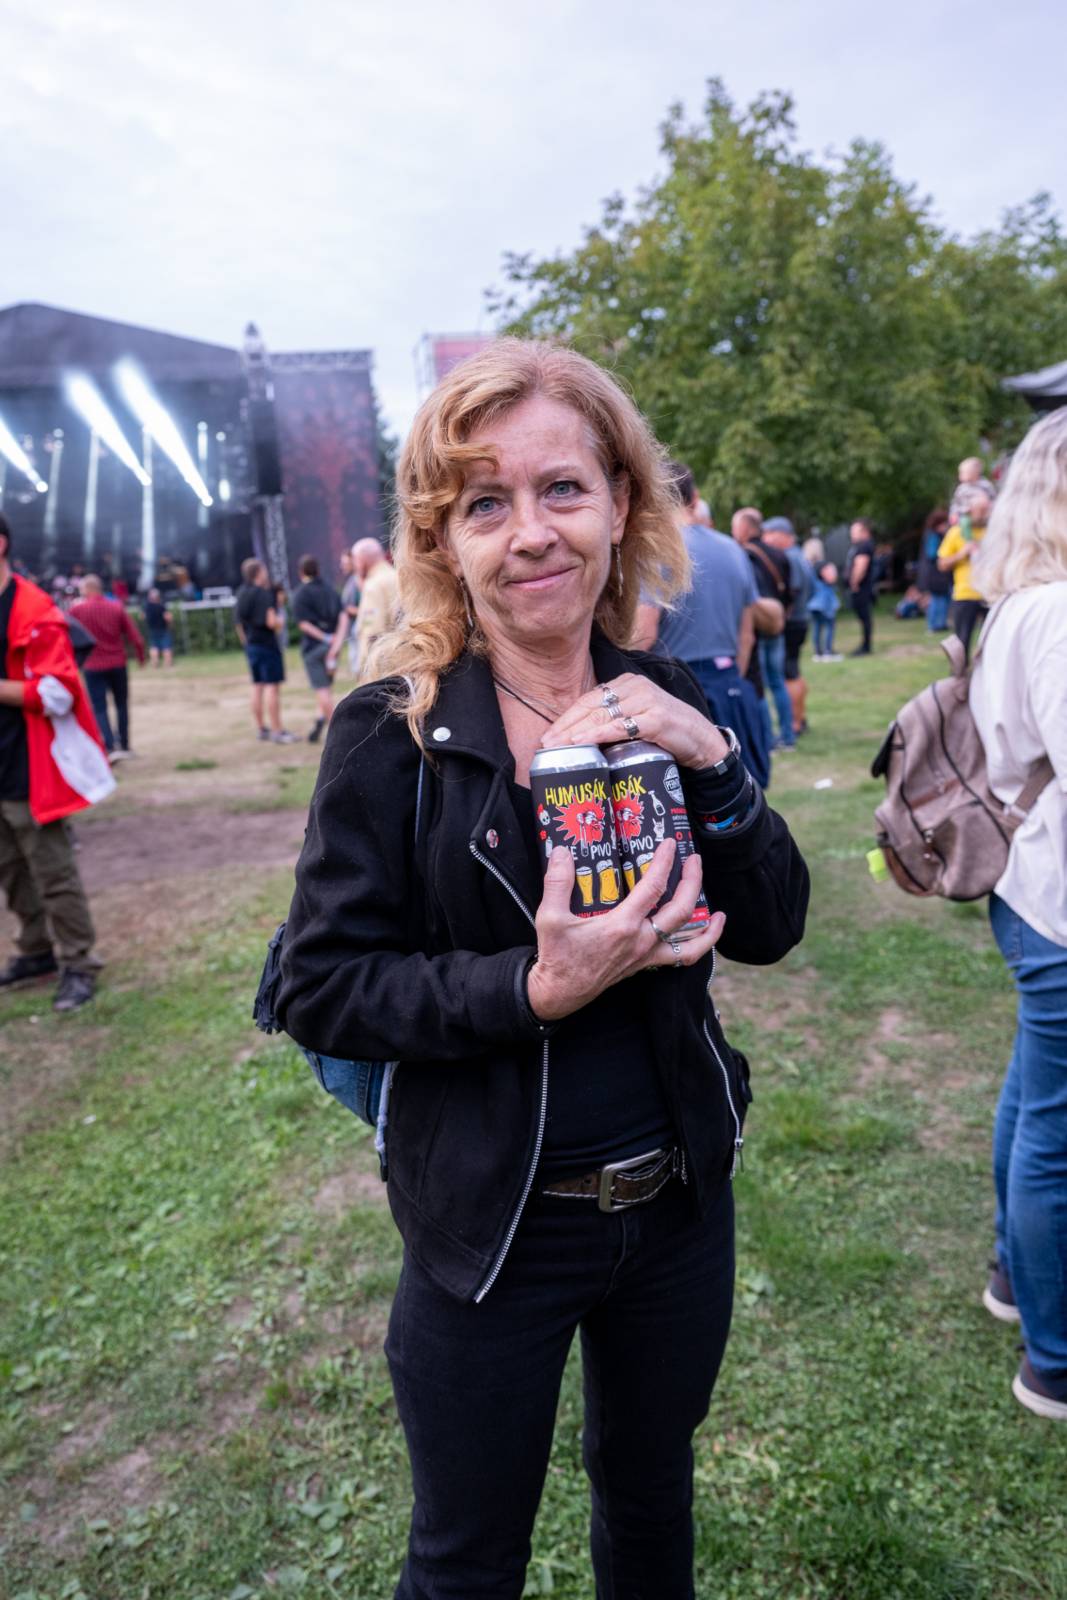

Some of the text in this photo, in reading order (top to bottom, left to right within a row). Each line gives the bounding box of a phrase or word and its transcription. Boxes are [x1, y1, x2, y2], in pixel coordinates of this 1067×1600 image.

[545, 779, 607, 807] HUMUSÁK
[611, 775, 647, 802] USÁK
[590, 842, 612, 860] PIVO
[630, 835, 654, 854] PIVO
